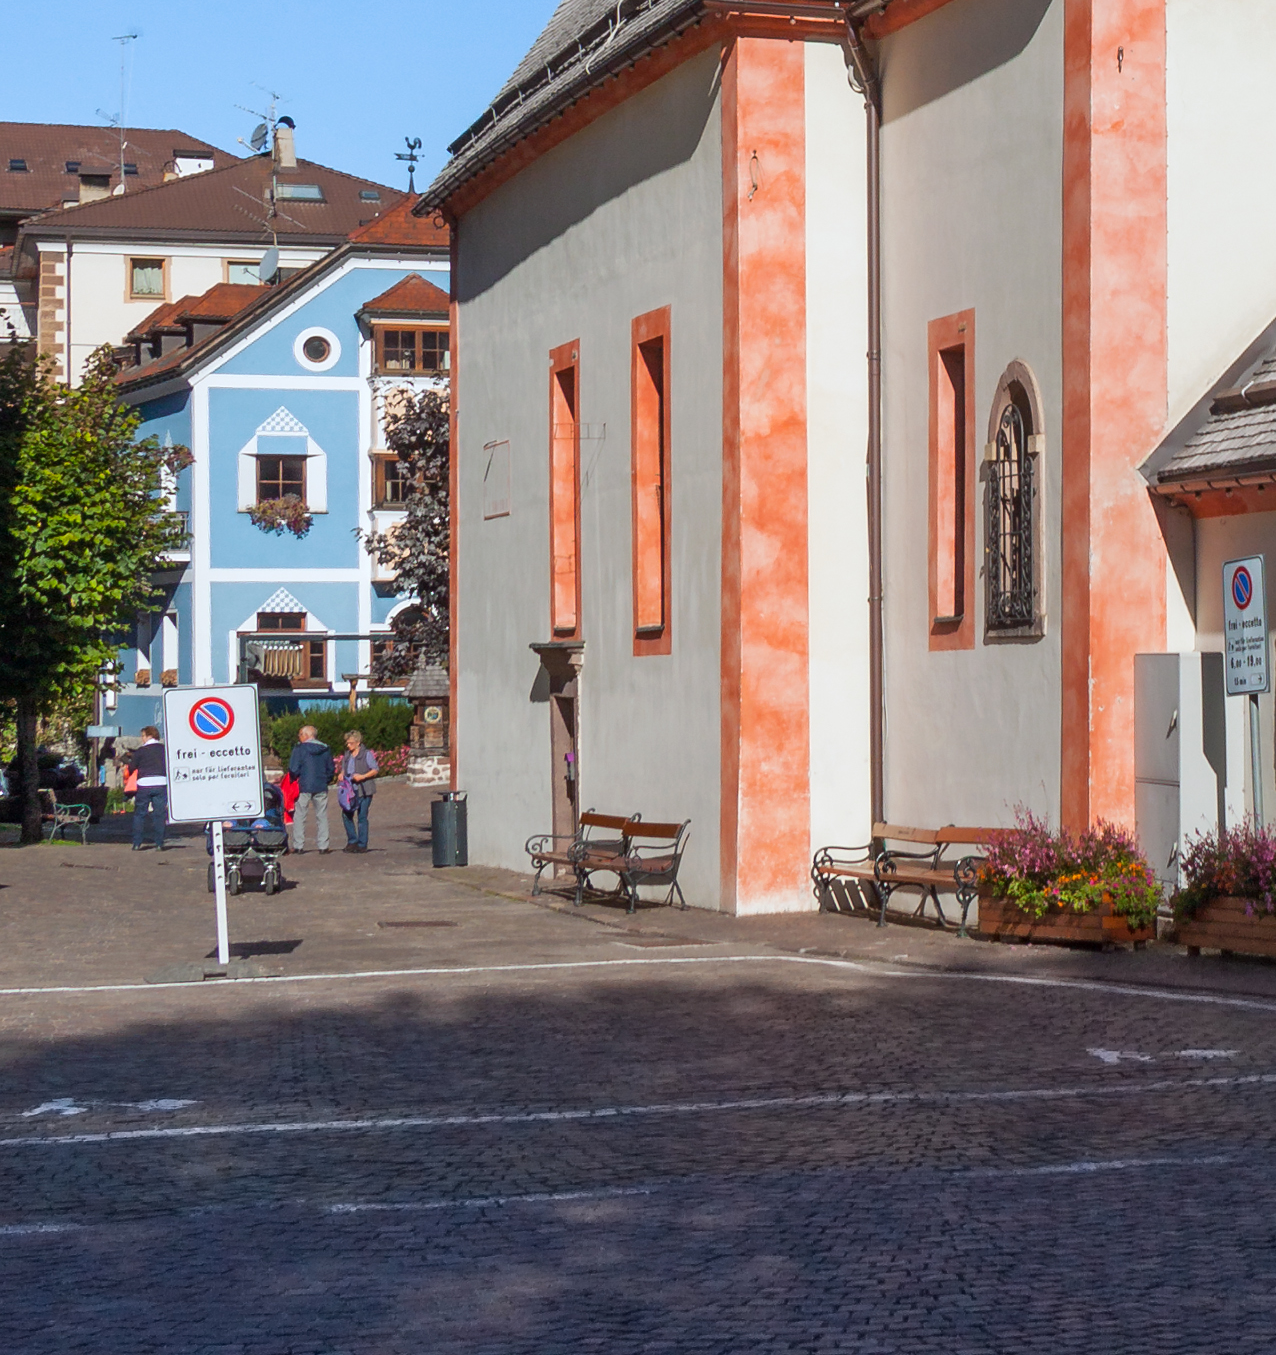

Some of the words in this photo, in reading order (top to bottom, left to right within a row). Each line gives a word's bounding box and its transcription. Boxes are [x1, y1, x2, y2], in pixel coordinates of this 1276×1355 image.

[1229, 619, 1237, 631] frei
[1242, 617, 1262, 628] eccetto
[177, 749, 197, 759] frei
[210, 746, 251, 757] eccetto
